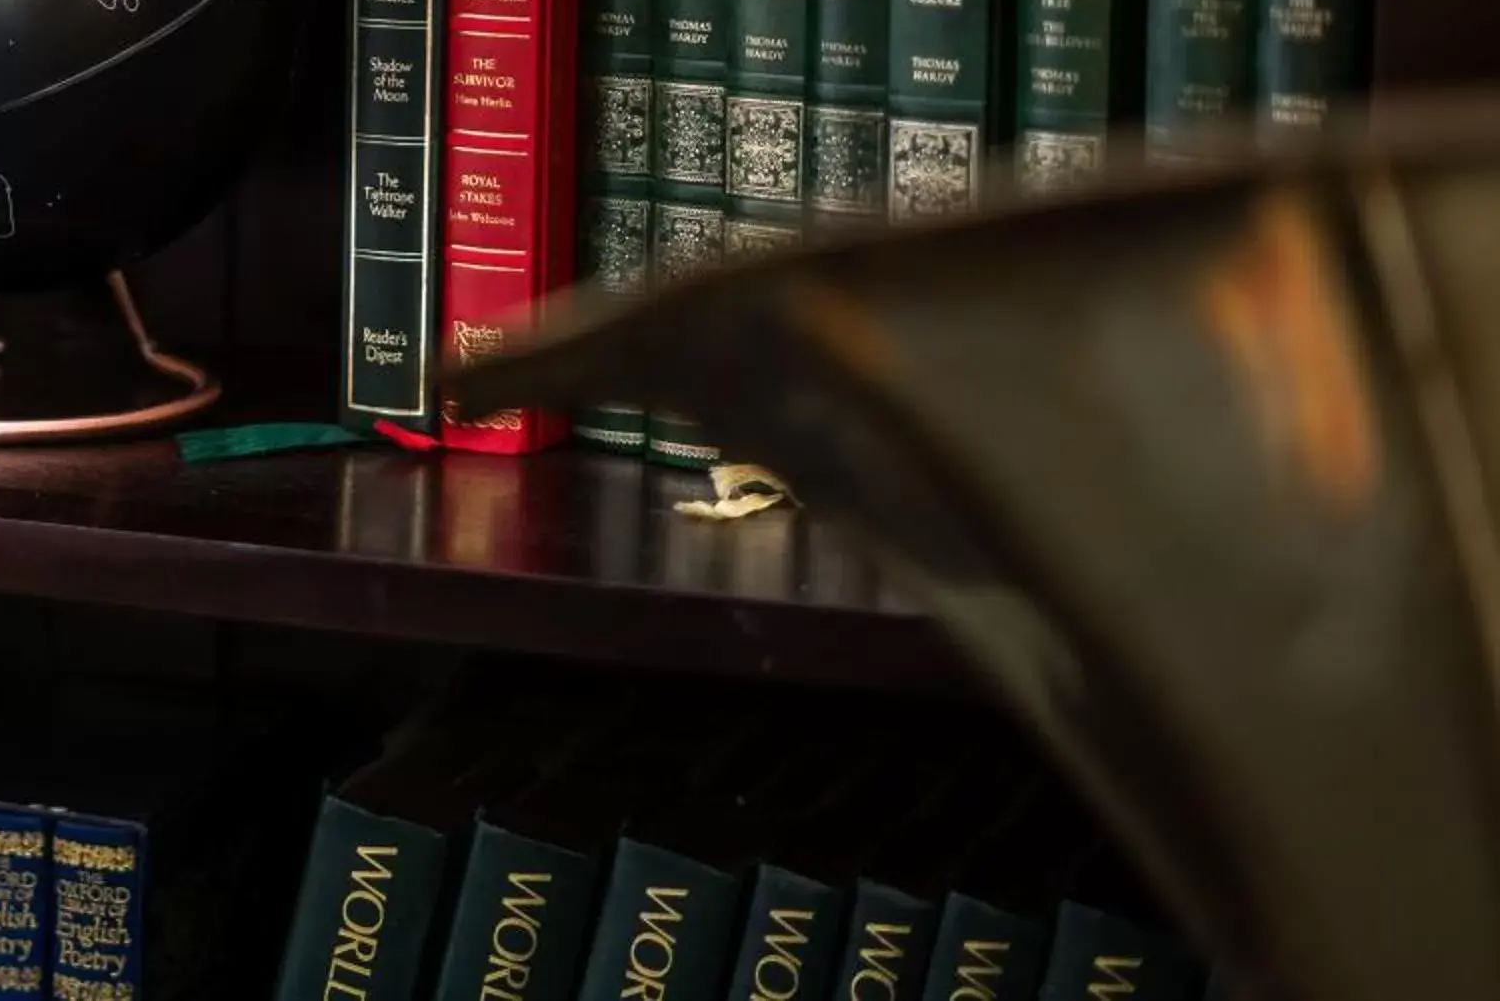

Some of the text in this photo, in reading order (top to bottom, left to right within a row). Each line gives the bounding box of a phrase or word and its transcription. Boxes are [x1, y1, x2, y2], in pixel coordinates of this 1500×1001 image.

[744, 34, 788, 48] THOMAS
[370, 57, 414, 72] Shadow
[472, 58, 497, 71] THE
[911, 55, 960, 72] THOMAS
[373, 74, 405, 88] of the
[453, 74, 516, 88] SURVIVOR
[913, 70, 957, 85] HARDY
[373, 88, 410, 104] Moon
[376, 172, 399, 188] The
[461, 174, 501, 188] ROYAL
[364, 186, 416, 205] Tightrope
[459, 190, 503, 206] STAKES
[368, 203, 408, 219] Walker
[363, 326, 409, 347] Reader's
[365, 344, 404, 366] Digest
[56, 878, 132, 904] OXFORD
[55, 911, 132, 948] English
[58, 939, 128, 978] Poetry
